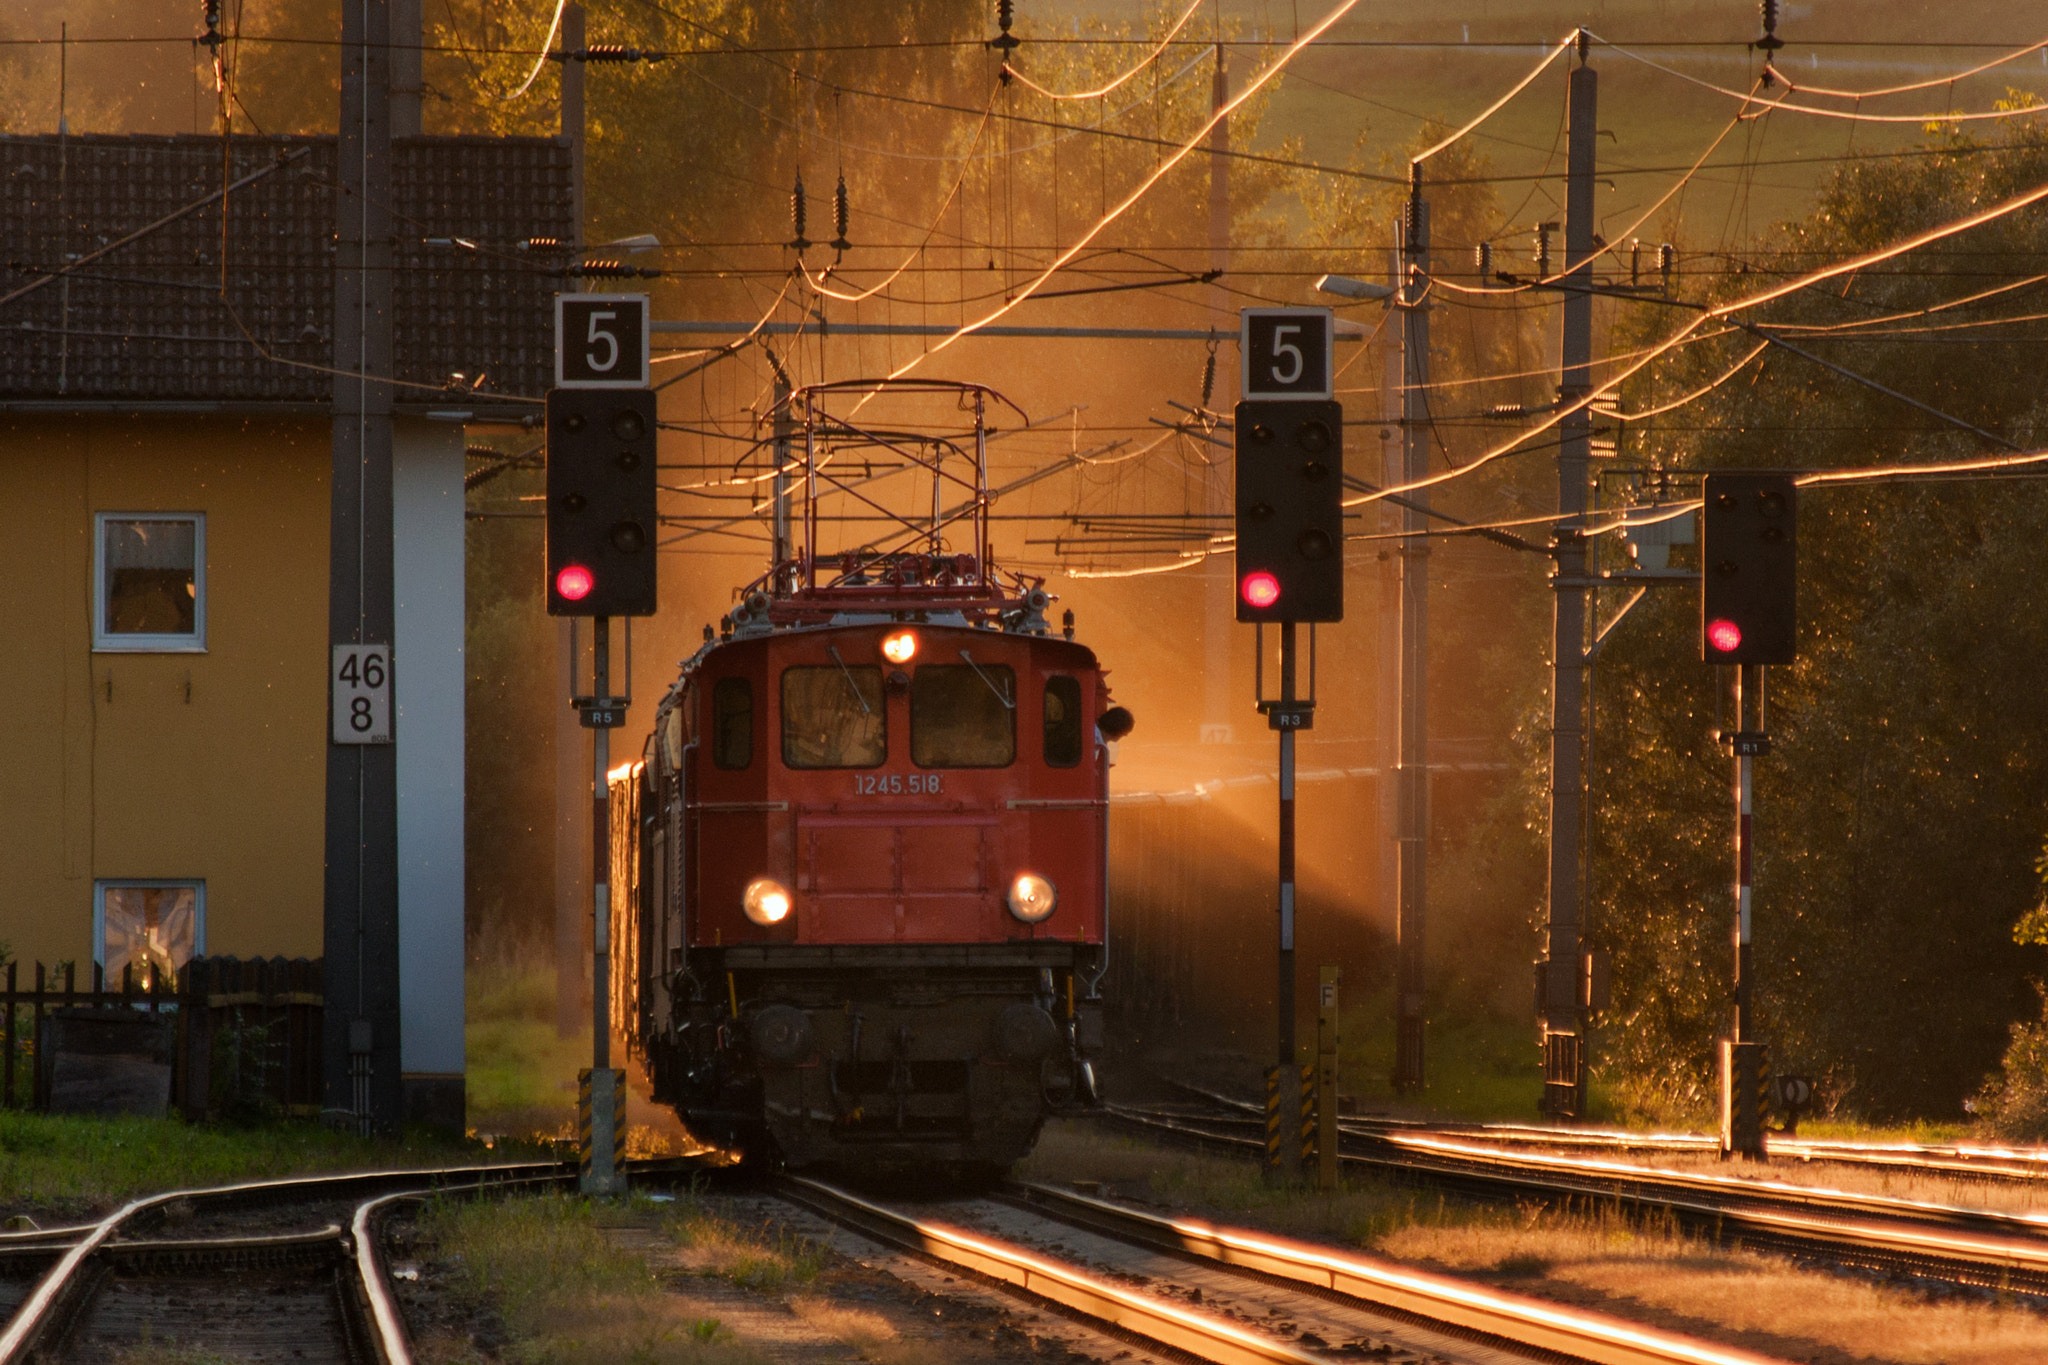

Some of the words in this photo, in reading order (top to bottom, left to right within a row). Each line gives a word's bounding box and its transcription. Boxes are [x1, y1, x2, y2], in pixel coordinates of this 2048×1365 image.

[586, 312, 618, 371] 5
[1272, 326, 1303, 384] 5
[339, 654, 385, 689] 46
[351, 697, 373, 732] 8
[857, 774, 940, 795] 1245.518
[1322, 986, 1333, 1006] F
